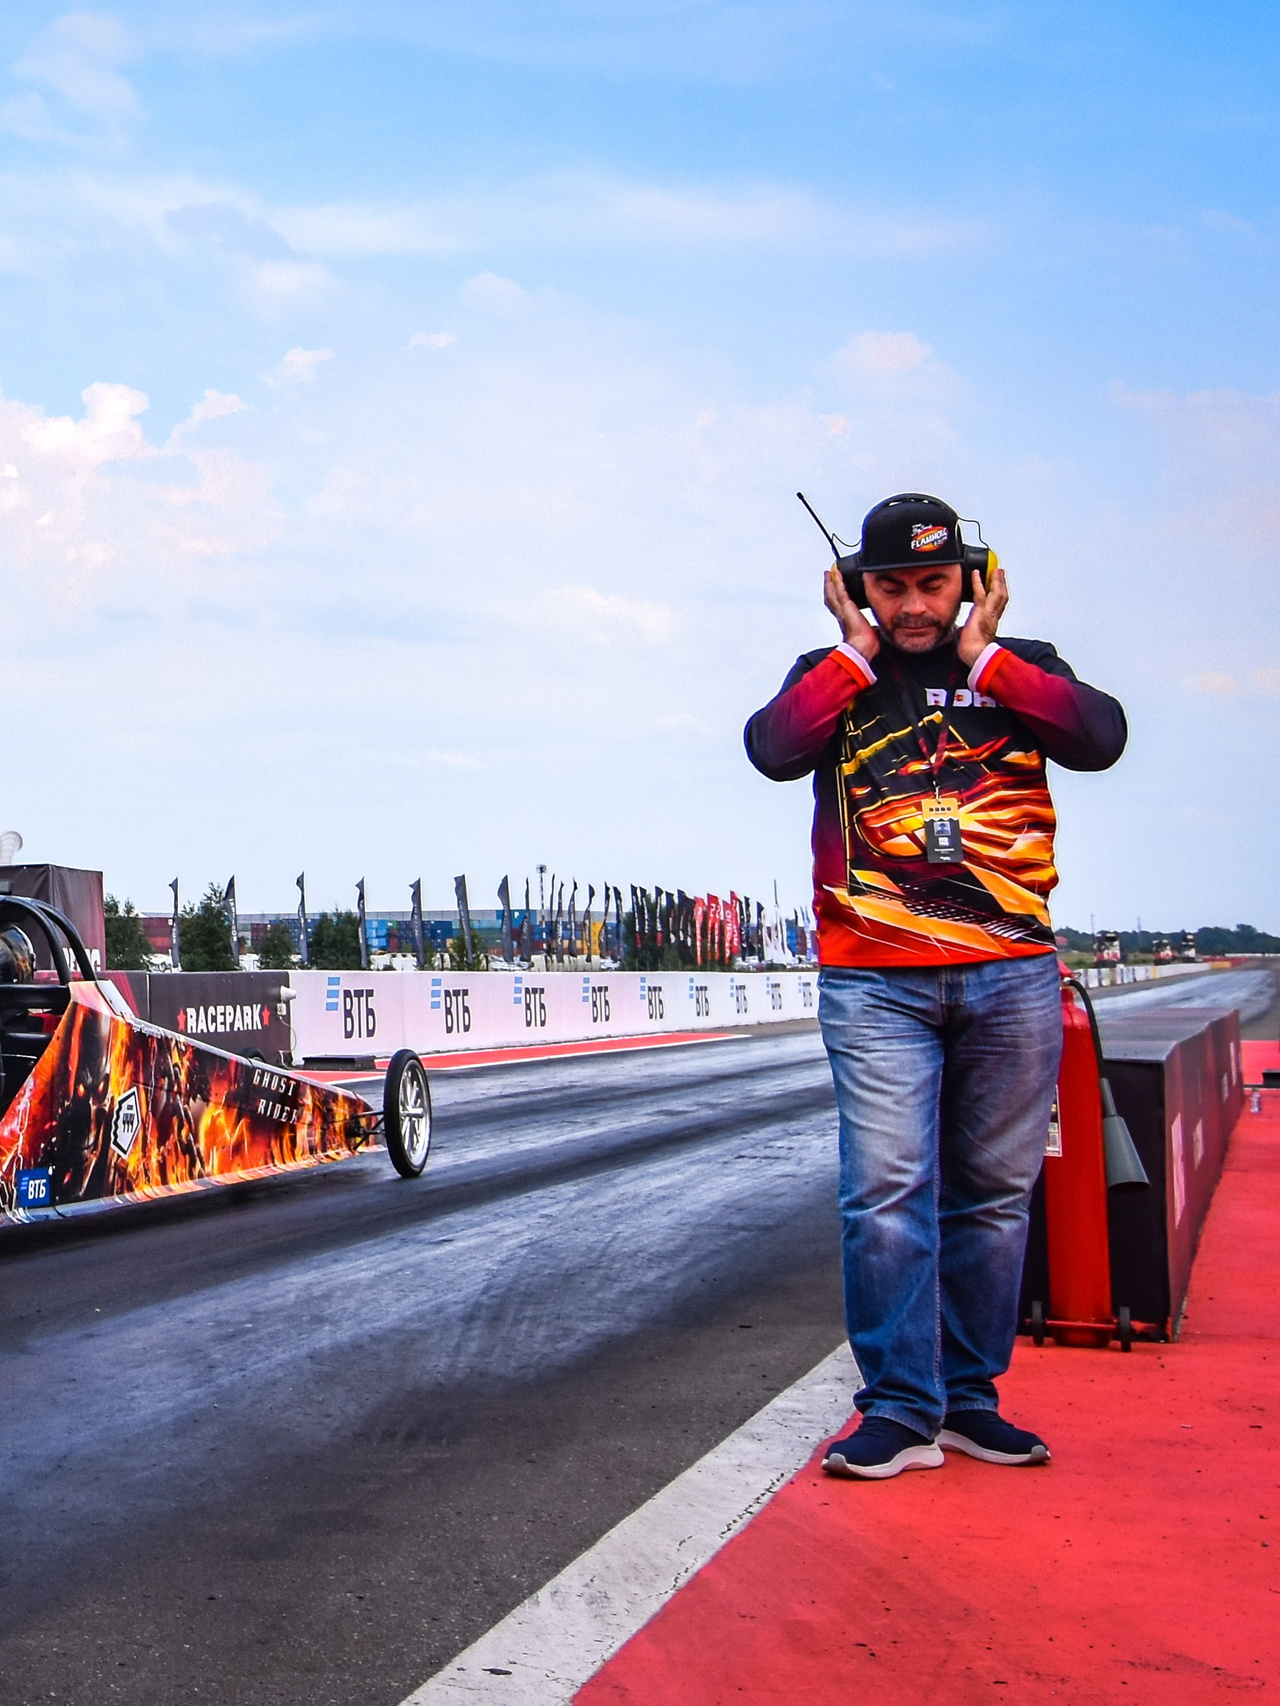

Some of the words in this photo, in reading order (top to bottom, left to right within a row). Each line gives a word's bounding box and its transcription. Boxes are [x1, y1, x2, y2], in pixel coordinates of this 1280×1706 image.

[343, 989, 377, 1039] ВТБ
[444, 988, 471, 1034] ВТБ
[524, 987, 547, 1027] ВТБ
[591, 985, 610, 1023] ВТБ
[647, 985, 664, 1020] ВТБ
[695, 985, 709, 1017] ВТБ
[186, 1003, 263, 1034] RACEPARK
[253, 1069, 296, 1096] GHOST
[257, 1098, 298, 1125] RIDER
[27, 1178, 47, 1200] ВТБ
